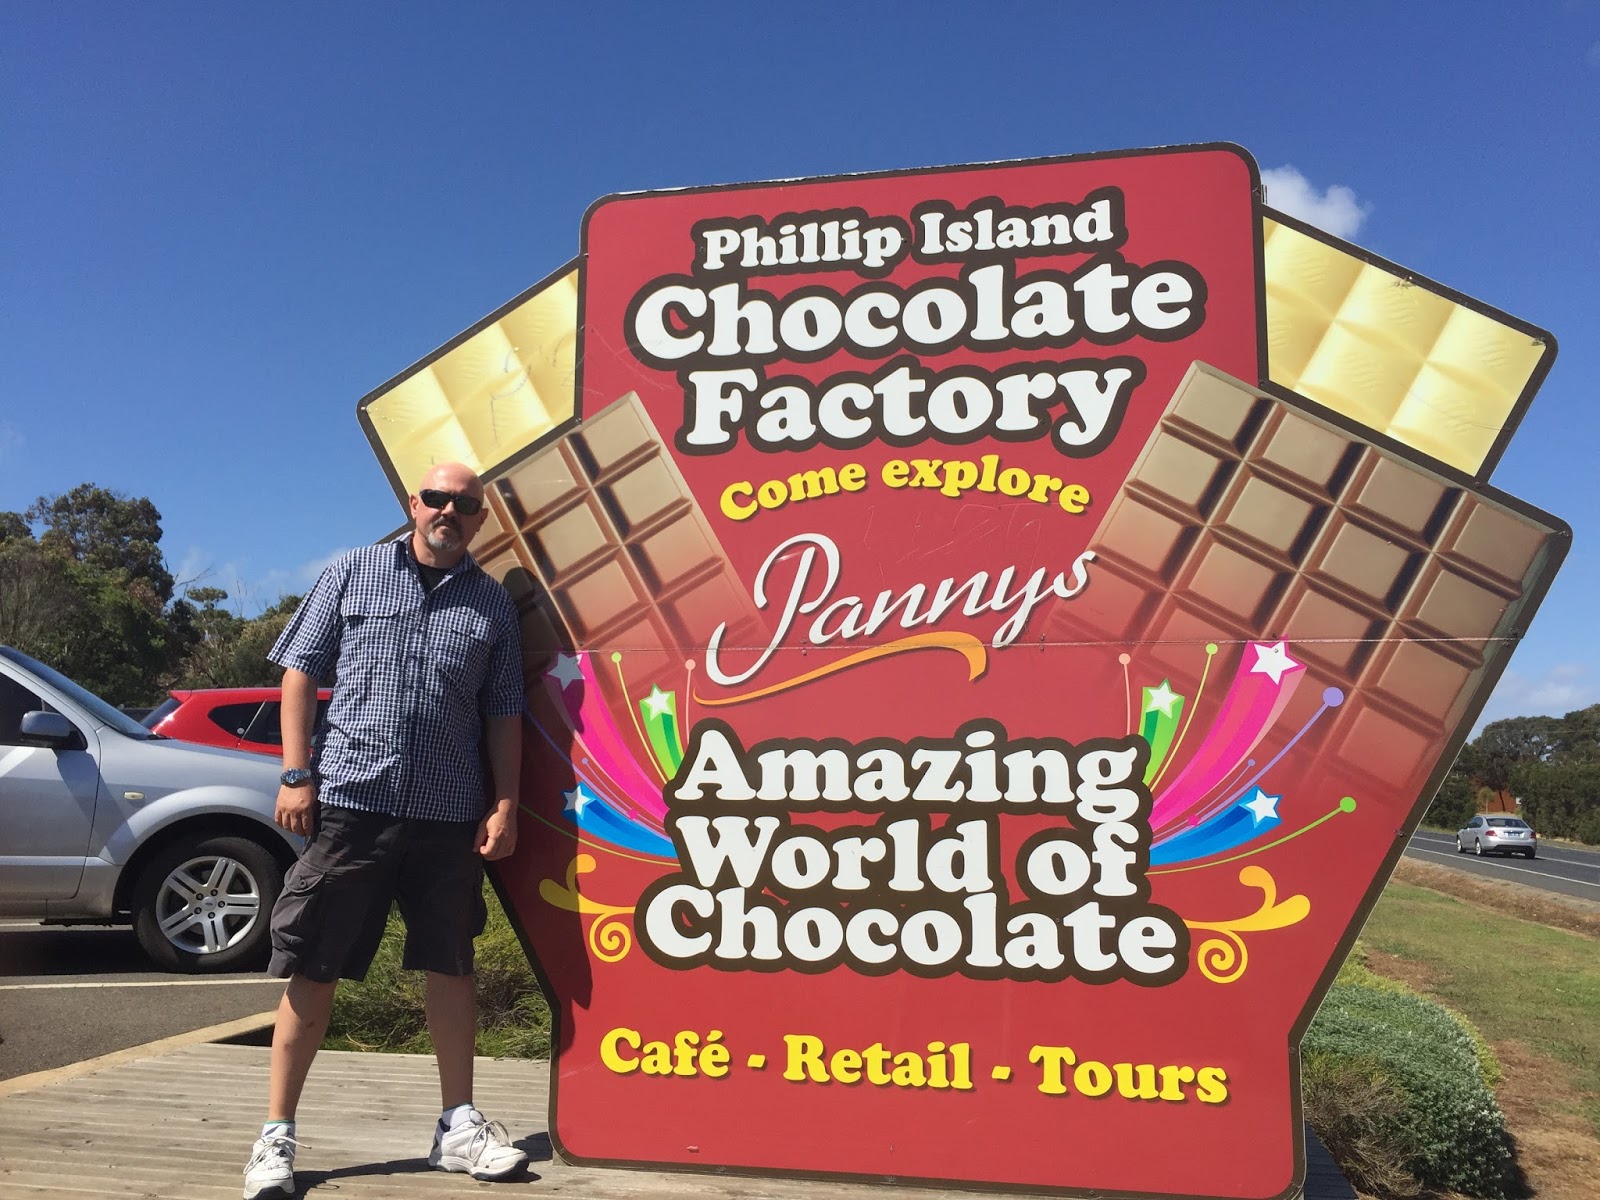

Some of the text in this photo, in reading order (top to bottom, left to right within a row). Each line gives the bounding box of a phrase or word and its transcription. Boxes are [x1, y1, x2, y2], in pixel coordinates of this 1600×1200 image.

[703, 200, 1114, 270] Phillip Island
[635, 264, 1193, 359] Chocolate
[686, 367, 1131, 445] Factory
[720, 455, 1090, 520] Come explore
[706, 533, 1096, 684] Pannys
[675, 730, 1138, 823] Amazing
[676, 816, 1138, 896] World of
[645, 886, 1176, 972] Chocolate
[600, 1028, 730, 1078] Café
[783, 1034, 971, 1090] Retail
[1029, 1046, 1229, 1103] Tours
